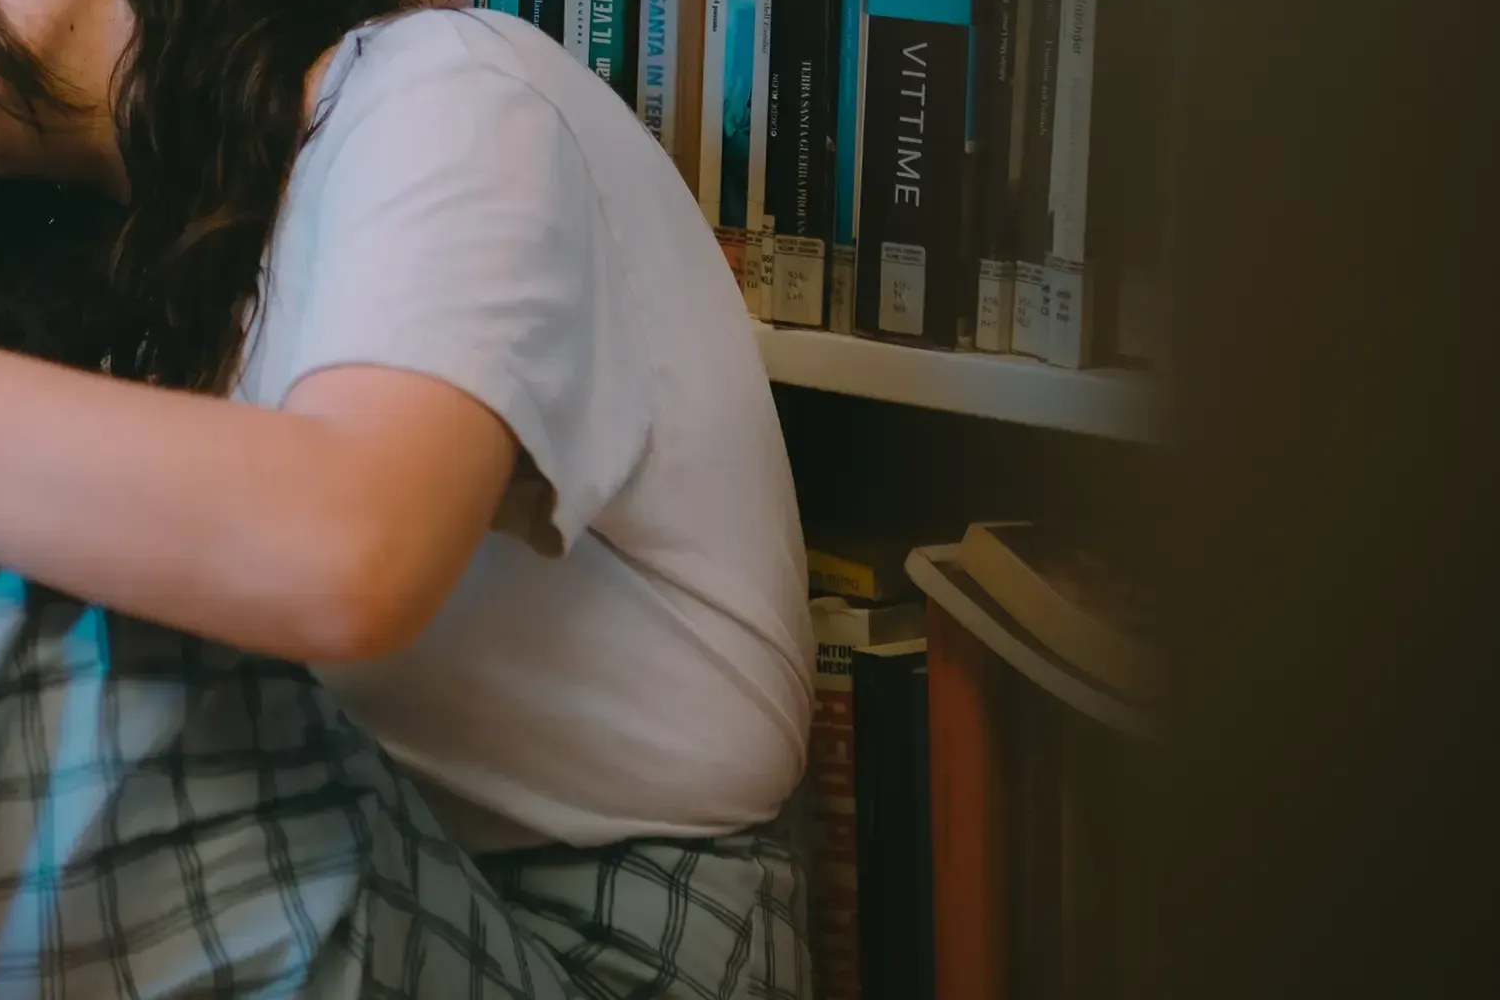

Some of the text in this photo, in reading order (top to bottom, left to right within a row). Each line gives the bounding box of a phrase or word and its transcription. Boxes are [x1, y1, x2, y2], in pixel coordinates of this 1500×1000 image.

[593, 28, 612, 44] IL
[596, 57, 611, 87] an
[646, 65, 664, 86] IN
[894, 42, 928, 208] VITTIME
[796, 59, 812, 234] TERRA SANTA GUERRA PROFAN
